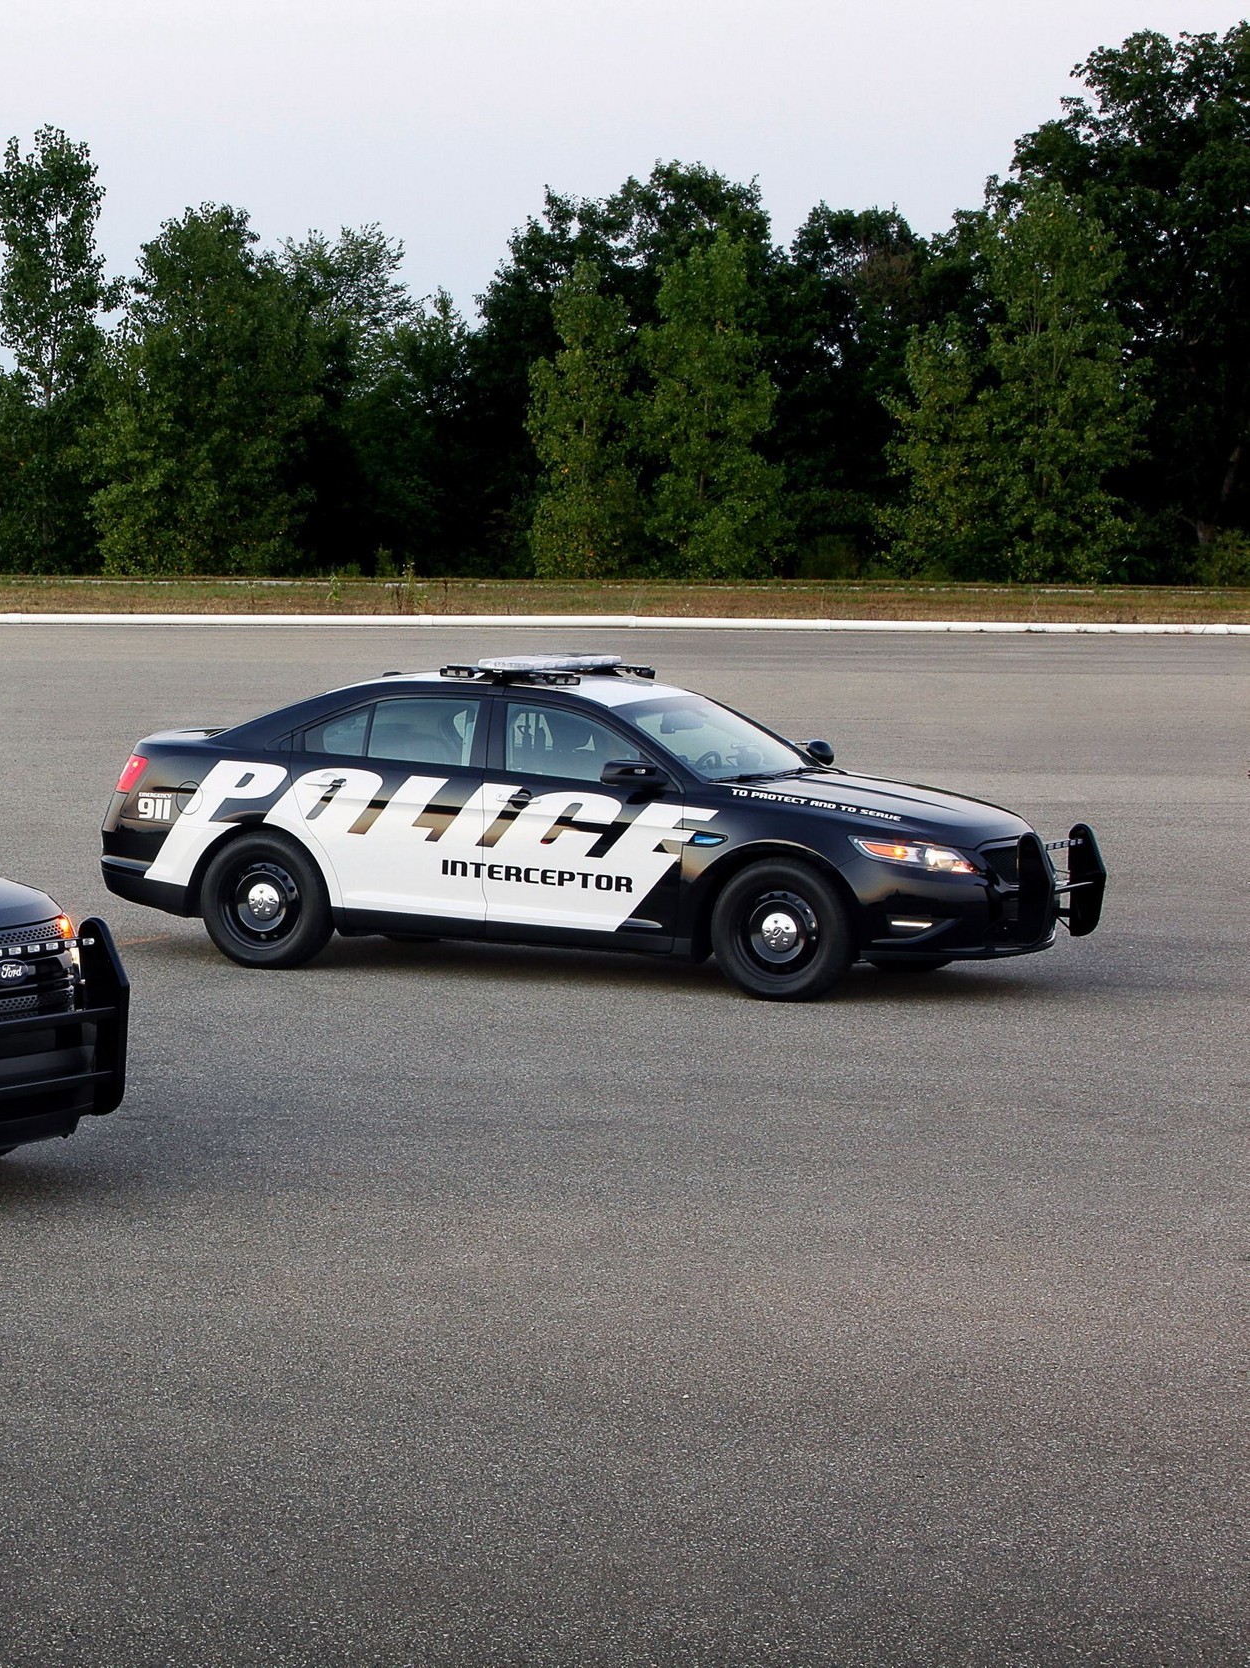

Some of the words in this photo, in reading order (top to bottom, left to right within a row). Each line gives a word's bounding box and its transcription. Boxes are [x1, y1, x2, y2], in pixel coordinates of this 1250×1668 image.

[137, 797, 172, 820] 911
[153, 759, 721, 866] POLICE
[731, 788, 749, 797] TO
[750, 791, 808, 805] PROTECT
[809, 800, 837, 810] AND
[839, 805, 857, 813] TO
[859, 809, 902, 822] SERVE
[441, 859, 634, 894] INTERCEPTOR
[1, 963, 24, 979] Ford
